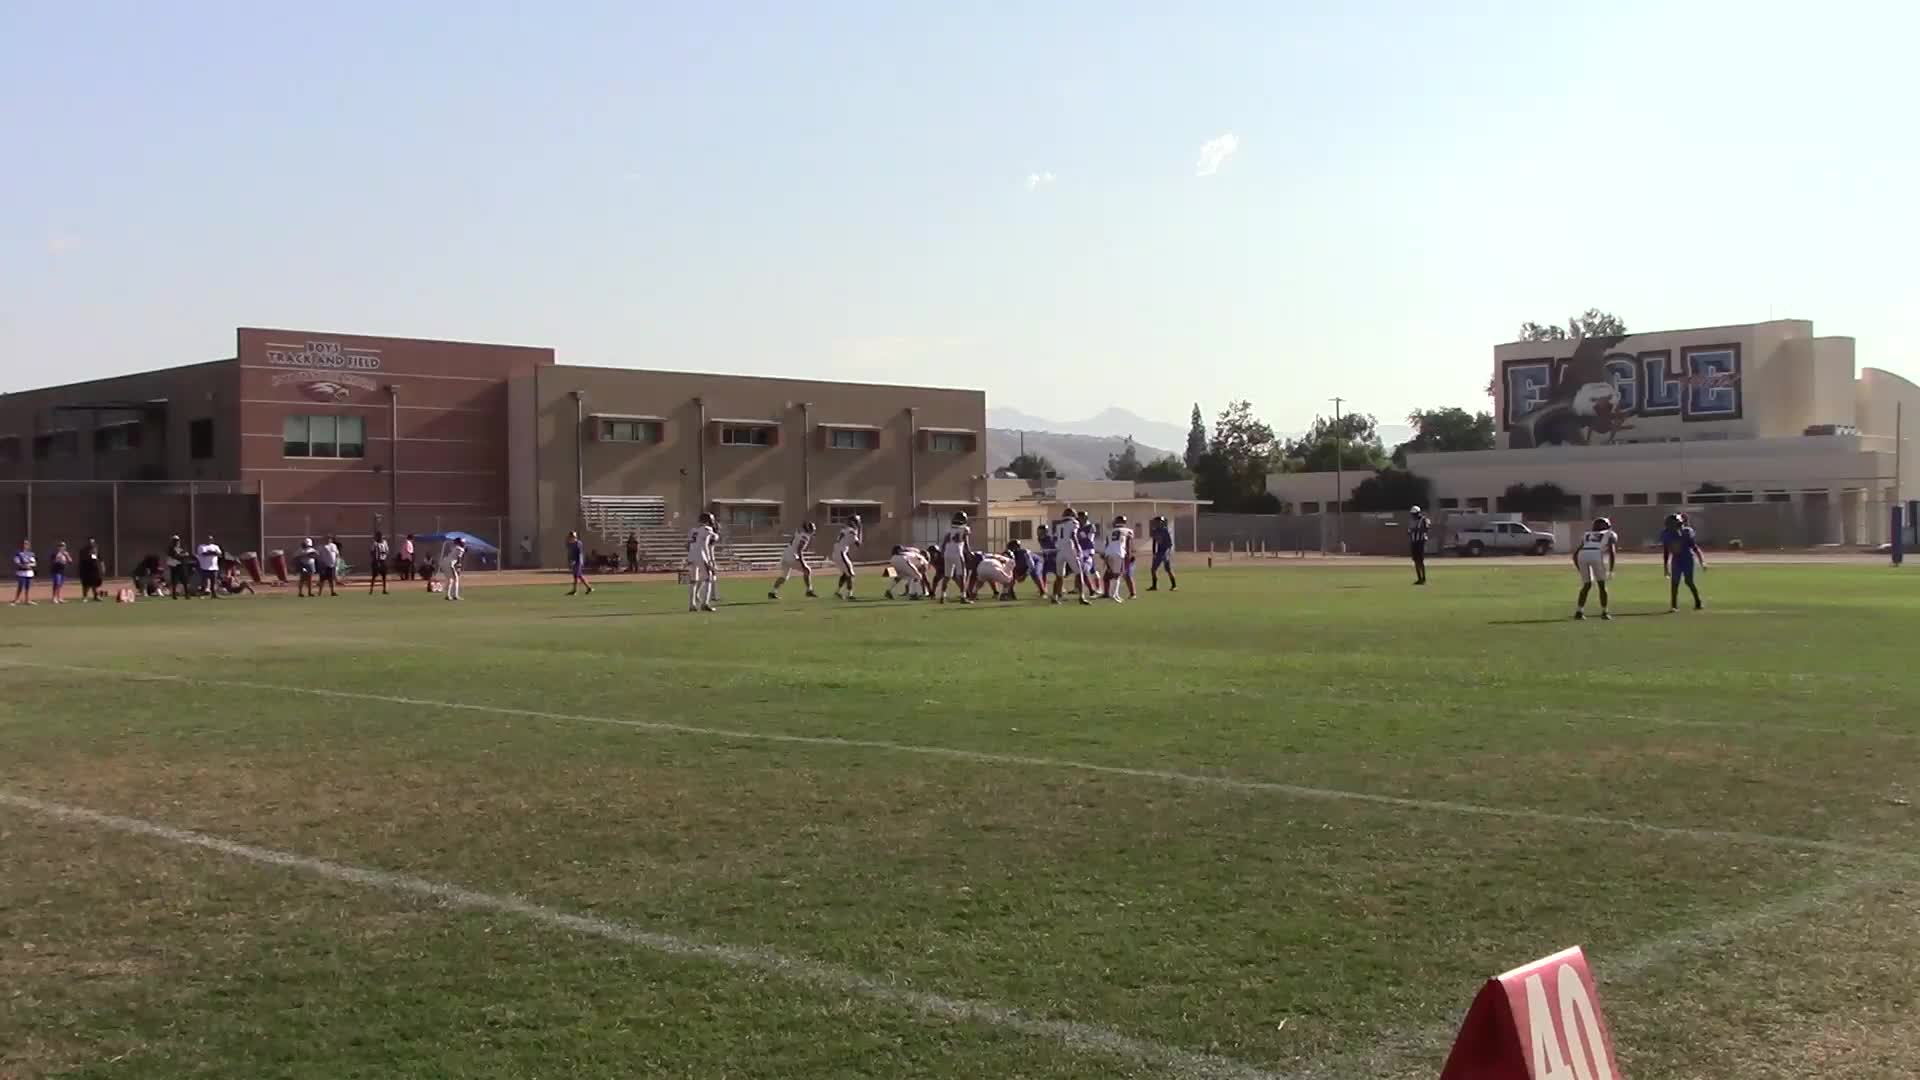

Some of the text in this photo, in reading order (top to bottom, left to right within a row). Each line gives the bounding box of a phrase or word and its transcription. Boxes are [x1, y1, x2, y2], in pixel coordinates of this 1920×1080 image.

[268, 350, 380, 369] TRACK AND FIELD
[307, 341, 340, 353] BOYS
[1502, 342, 1742, 433] EGLE
[1525, 963, 1612, 1080] 40
